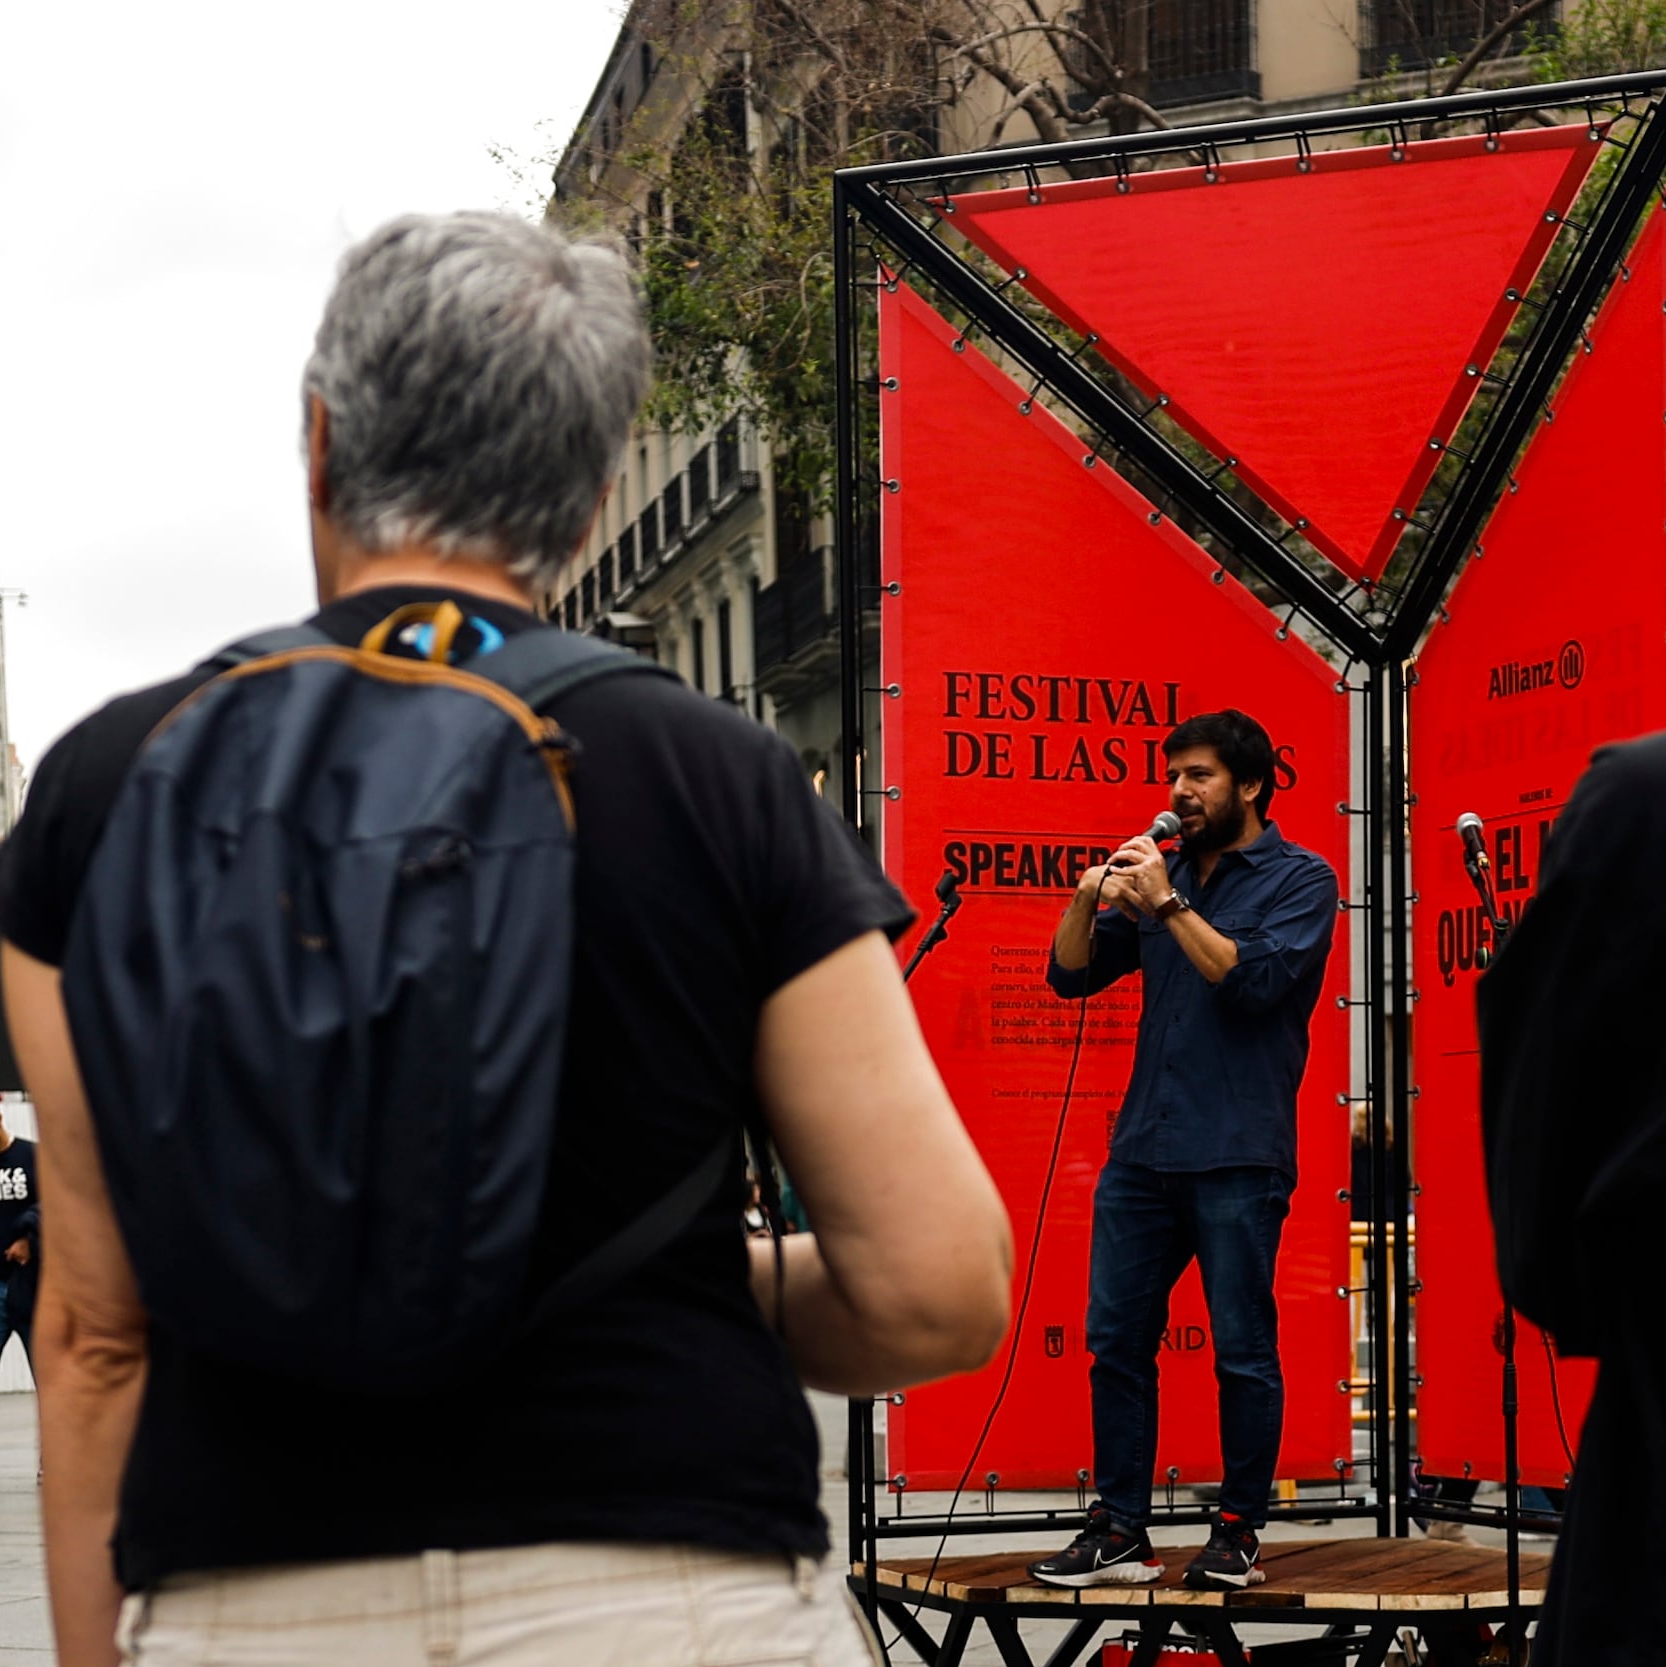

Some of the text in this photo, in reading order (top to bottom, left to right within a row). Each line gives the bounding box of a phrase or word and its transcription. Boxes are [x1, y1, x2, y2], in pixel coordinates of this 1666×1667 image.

[942, 671, 1183, 727] FESTIVAL
[1488, 660, 1555, 700] Allianz
[943, 730, 1015, 779] DE
[1029, 735, 1129, 784] LAS
[1495, 825, 1530, 893] EL
[1023, 1000, 1035, 1009] de
